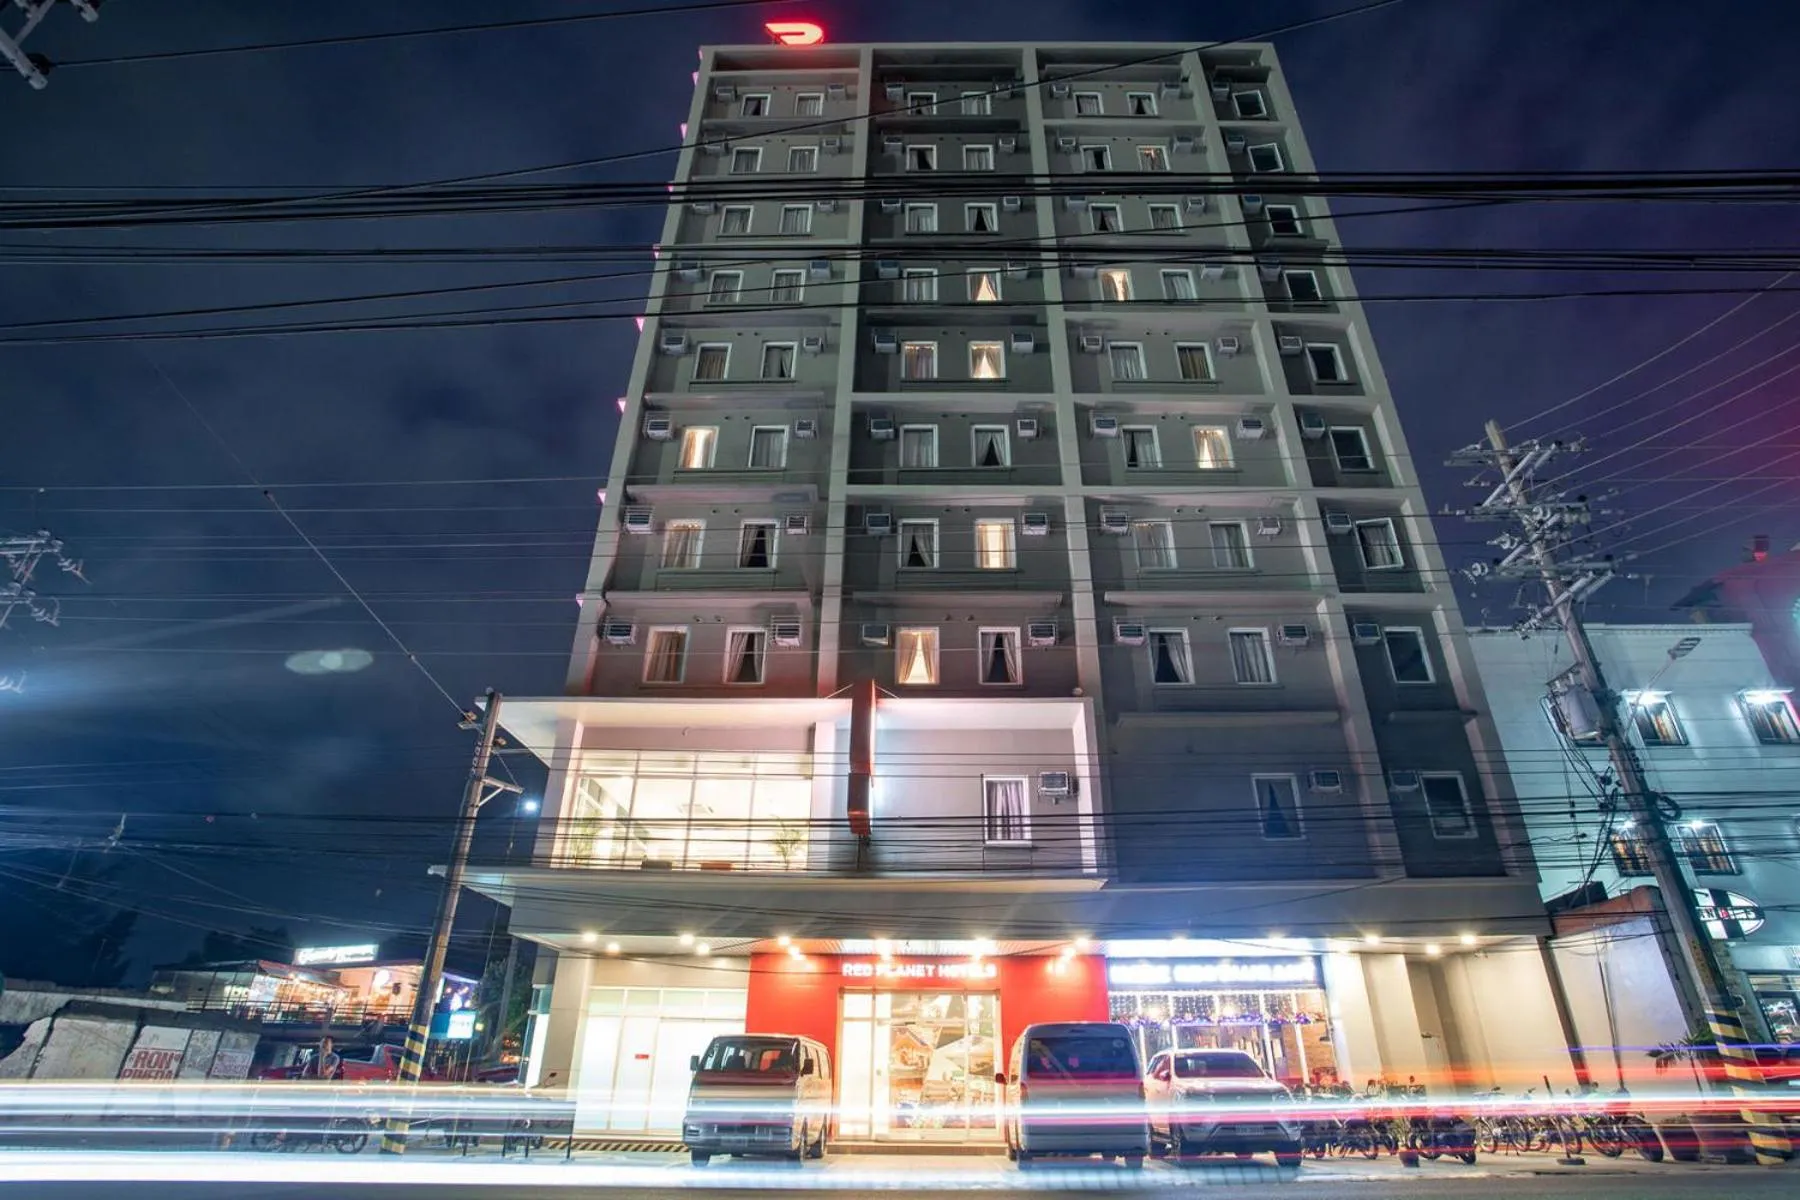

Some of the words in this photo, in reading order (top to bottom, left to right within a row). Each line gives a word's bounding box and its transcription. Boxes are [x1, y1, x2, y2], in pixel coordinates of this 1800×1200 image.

[842, 963, 873, 976] RED
[876, 963, 937, 977] PLANET
[131, 1050, 175, 1069] RON
